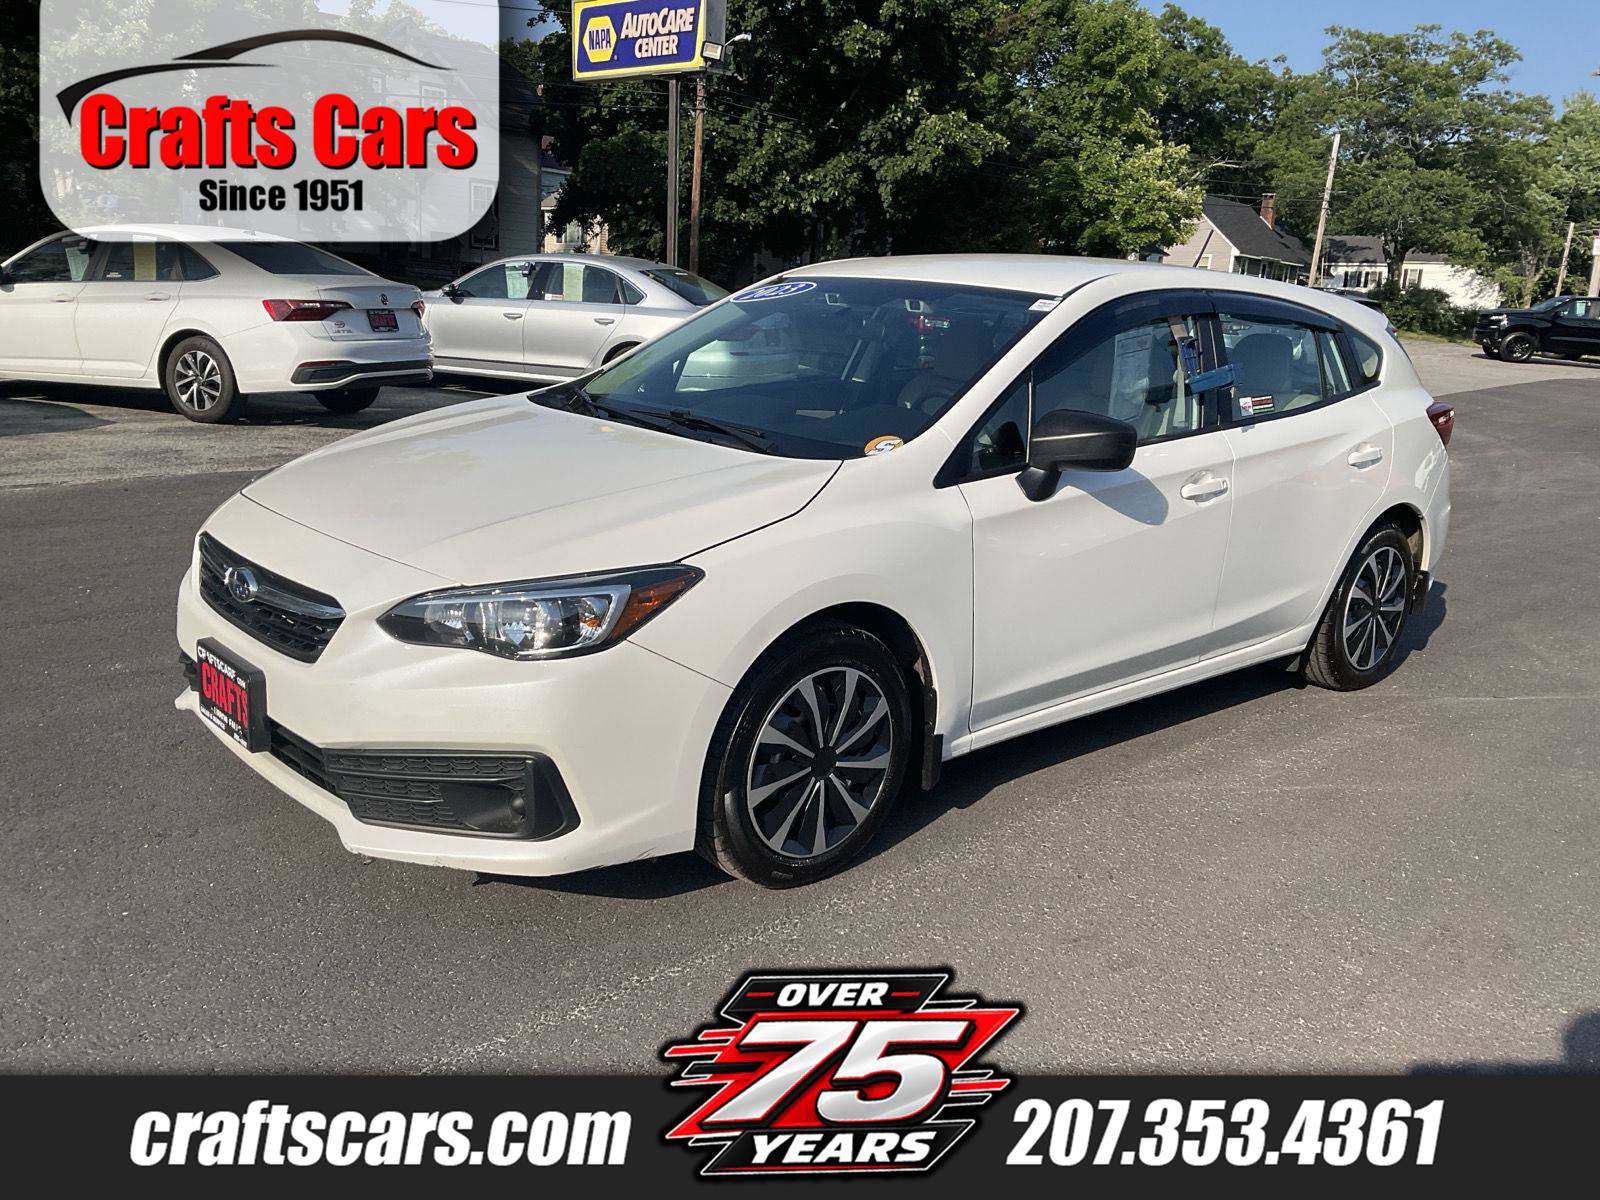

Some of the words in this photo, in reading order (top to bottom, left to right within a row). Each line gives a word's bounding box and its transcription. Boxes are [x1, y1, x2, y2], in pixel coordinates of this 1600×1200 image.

[620, 7, 695, 40] AUTOCARE
[588, 27, 612, 51] NAPA
[634, 34, 678, 59] CENTER
[201, 661, 249, 729] CRAFTS
